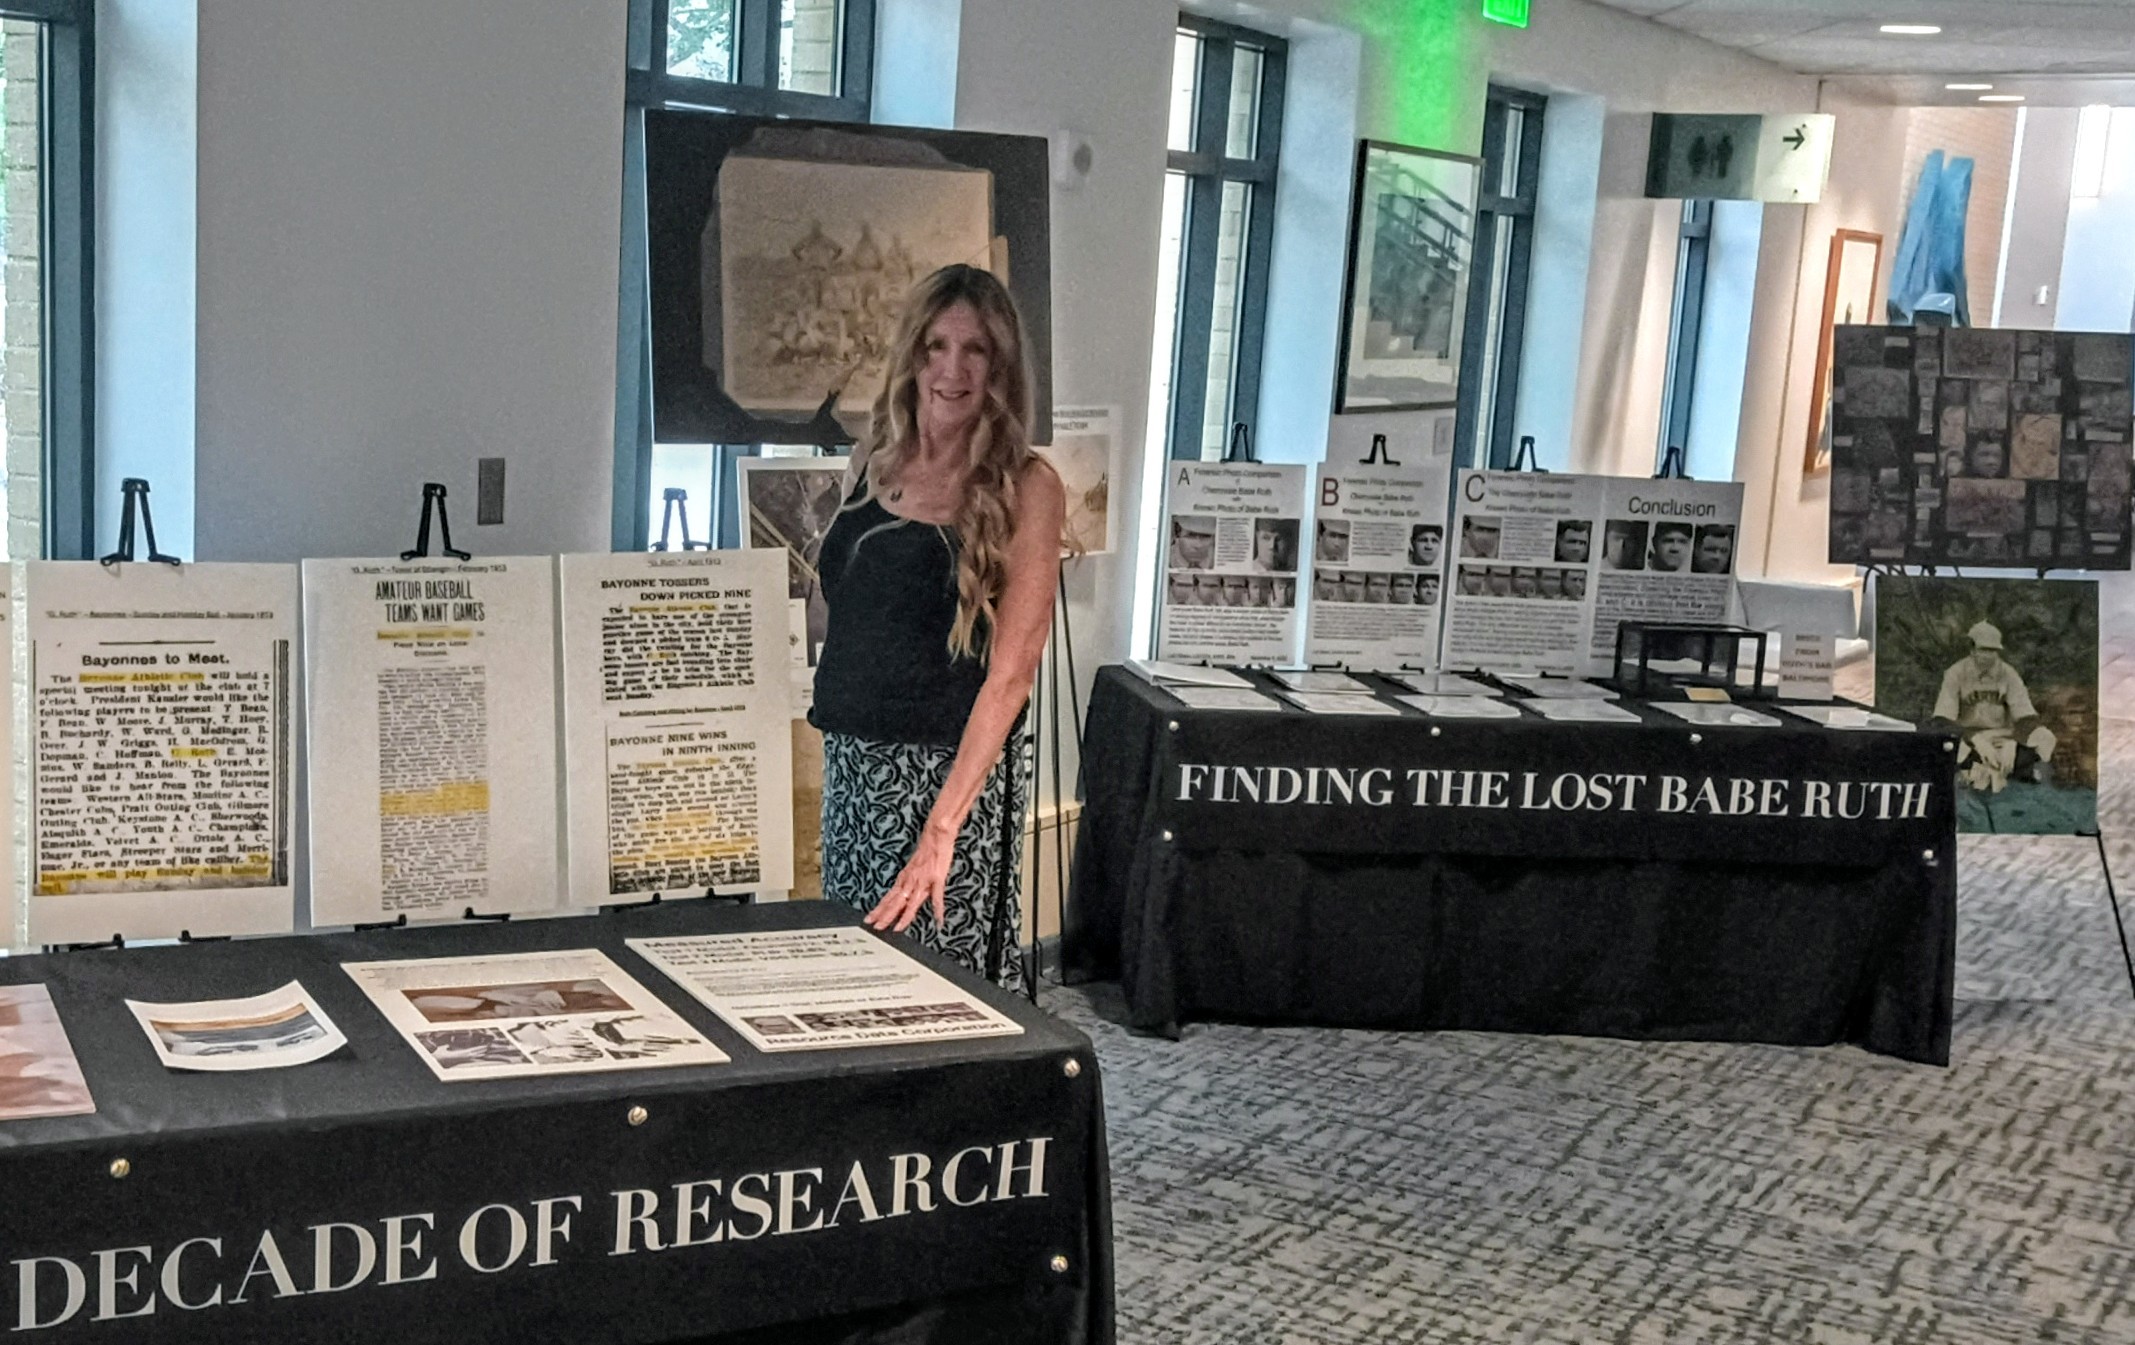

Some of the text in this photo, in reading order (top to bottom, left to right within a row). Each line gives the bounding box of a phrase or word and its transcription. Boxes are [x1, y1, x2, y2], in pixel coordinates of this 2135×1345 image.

[1177, 468, 1190, 486] A
[1321, 477, 1339, 506] B
[1465, 474, 1485, 502] C
[1628, 496, 1716, 518] Conclusion
[375, 579, 474, 600] AMATEUR BASEBALL
[601, 577, 710, 589] BAYONNE TOSSERS
[640, 589, 752, 601] DOWN PICKED NINE
[385, 602, 486, 623] TEAMS WANT GAMES
[165, 653, 180, 664] to
[610, 731, 727, 746] BAYONNE NINE WINS
[662, 741, 756, 756] IN NINTH INNING
[1176, 763, 1932, 820] FINDING THE LOST BABE RUTH
[766, 1022, 1007, 1045] Resource Data Corporation
[10, 1137, 1054, 1332] DECADE OF RESEARCH
